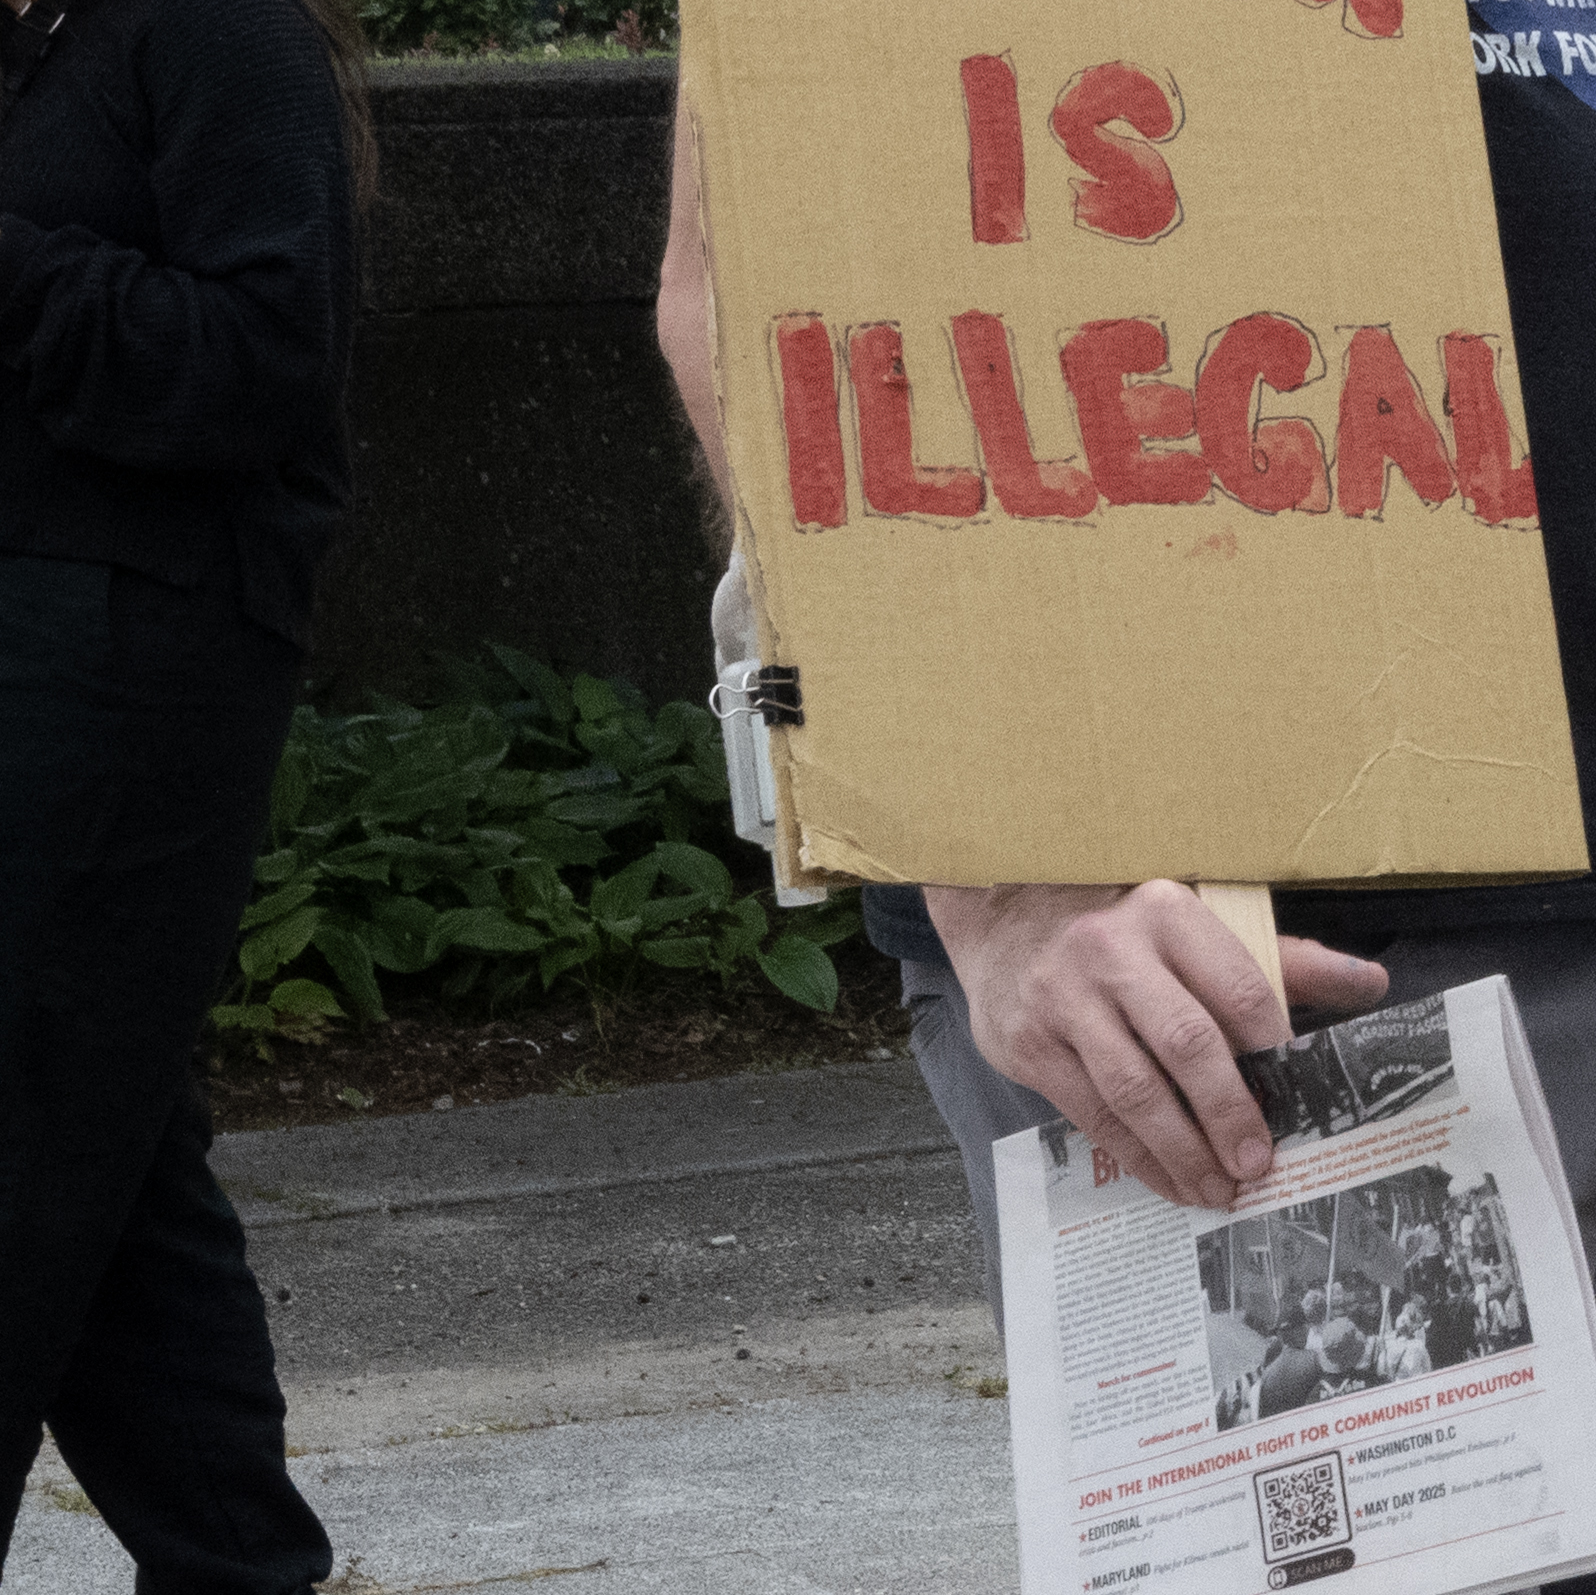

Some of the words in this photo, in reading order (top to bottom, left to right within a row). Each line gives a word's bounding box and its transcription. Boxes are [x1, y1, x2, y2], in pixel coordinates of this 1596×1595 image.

[1469, 30, 1547, 77] ORK
[959, 51, 1186, 245] IS
[768, 308, 1541, 532] ILLEGAL
[1079, 1487, 1112, 1510] JOIN
[1117, 1479, 1143, 1499] THE
[1147, 1446, 1253, 1490] INTERNATIONAL
[1256, 1432, 1296, 1457] FIGHT
[1300, 1424, 1329, 1444] FOR
[1334, 1395, 1431, 1434] COMMUNIST
[1436, 1366, 1535, 1406] REVOLUTION
[1355, 1431, 1433, 1464] WASHINGTON
[1435, 1425, 1457, 1445] D.C
[1365, 1494, 1389, 1517] MAY
[1393, 1489, 1415, 1510] DAY
[1418, 1483, 1447, 1504] 2025
[1087, 1515, 1143, 1542] EDITORIAL
[1091, 1562, 1151, 1590] MARYLAND
